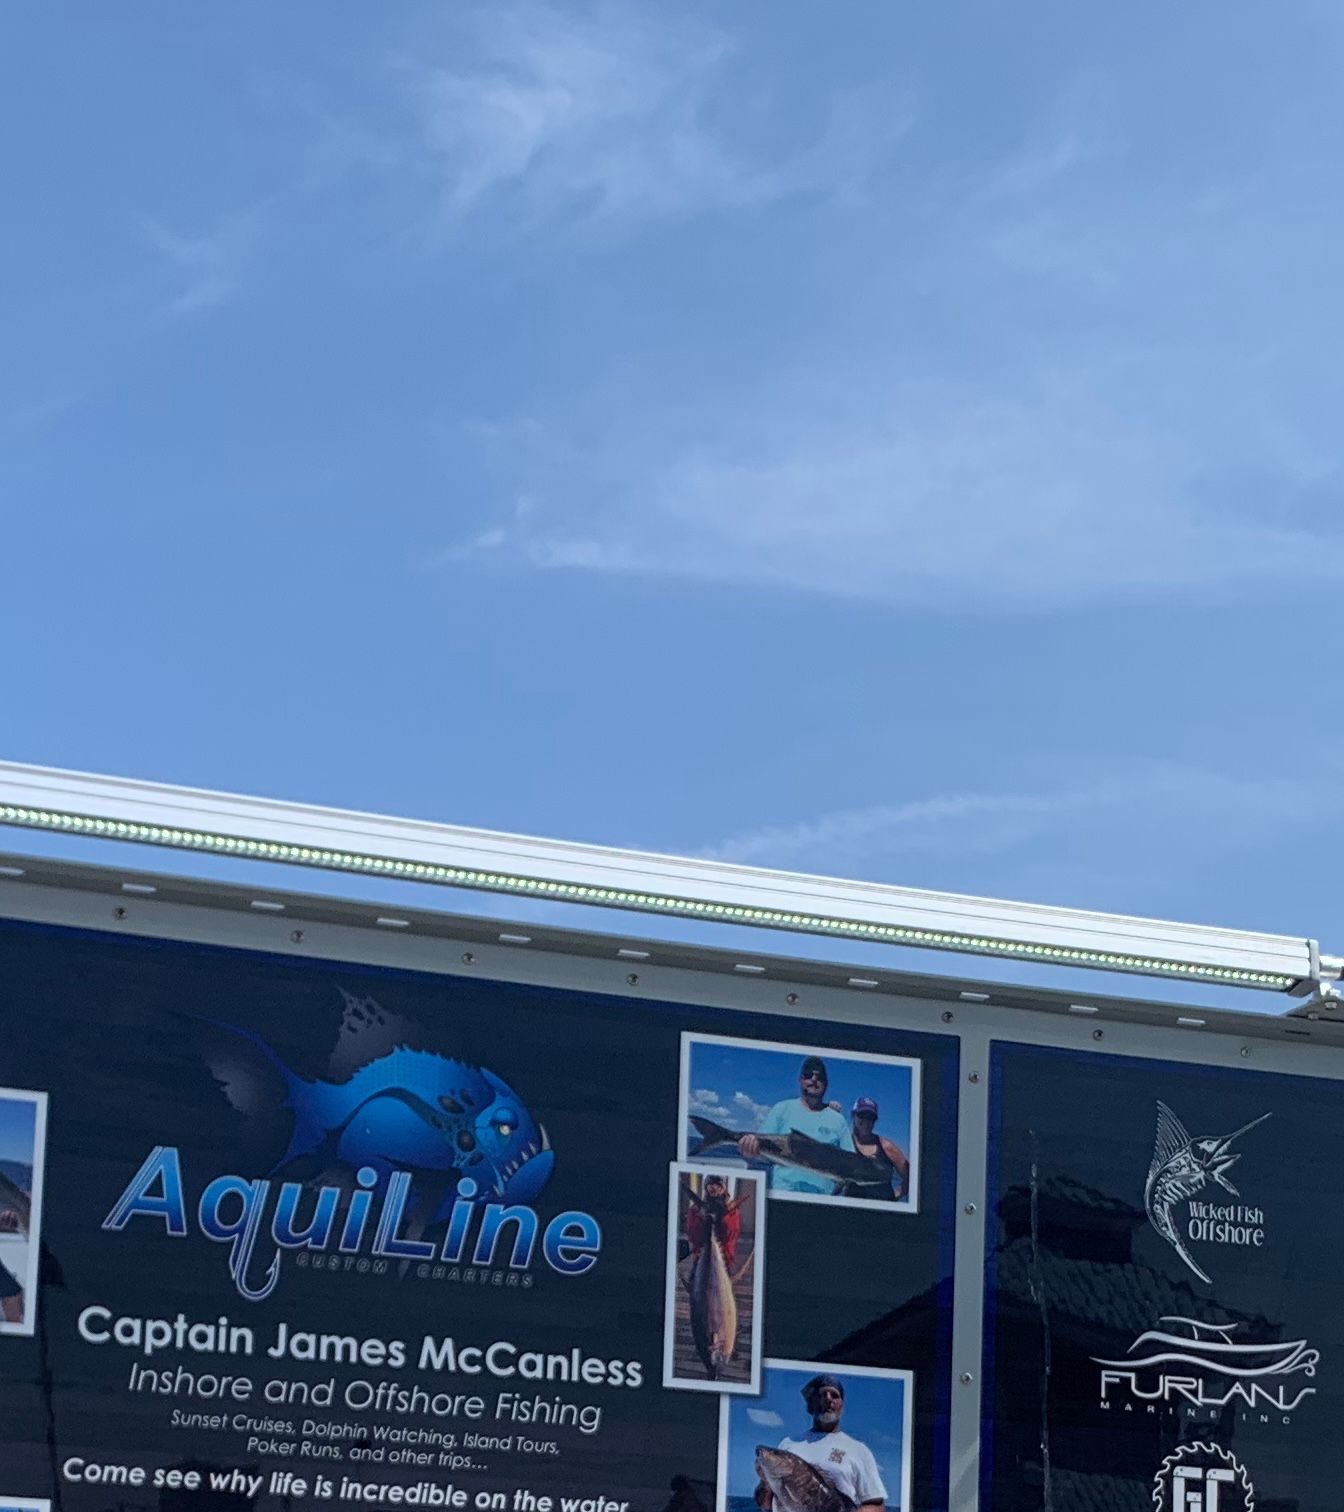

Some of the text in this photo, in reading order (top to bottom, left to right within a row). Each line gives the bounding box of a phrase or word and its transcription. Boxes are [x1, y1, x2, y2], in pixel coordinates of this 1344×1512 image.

[102, 1145, 602, 1300] AquiLine
[1188, 1218, 1265, 1247] Offshore
[1189, 1201, 1264, 1224] Wicked Fish
[296, 1251, 534, 1289] CUSTOM CHARTERS
[77, 1305, 644, 1388] Captain James McCanless
[128, 1361, 602, 1434] Inshore and Offshore Fishing
[1100, 1370, 1317, 1410] FURLANS
[171, 1409, 228, 1429] Sunset
[232, 1414, 297, 1435] Cruises,
[302, 1419, 368, 1440] Dolphin
[463, 1432, 513, 1450] Island
[516, 1436, 561, 1455] Tours,
[1100, 1401, 1291, 1425] MARINE INC
[246, 1436, 489, 1470] Poker Runs, and other trips...
[62, 1456, 147, 1487] Come
[153, 1469, 202, 1489] see
[209, 1468, 264, 1499] why
[269, 1471, 308, 1496] life
[313, 1474, 334, 1498] is
[338, 1475, 469, 1509] incredible
[474, 1489, 507, 1511] on
